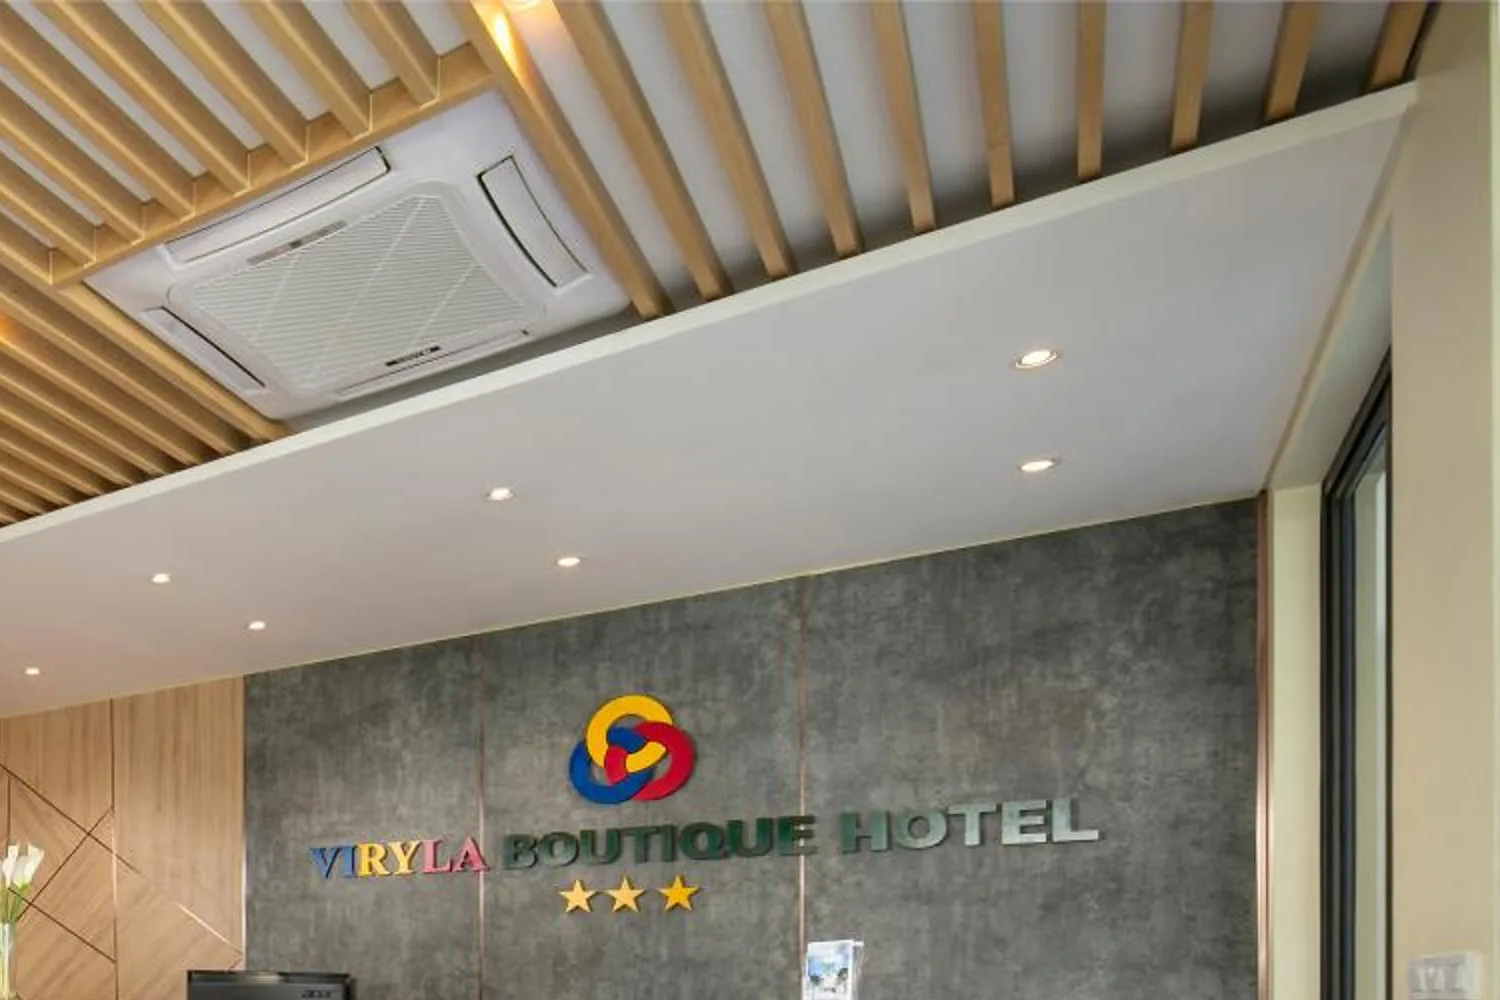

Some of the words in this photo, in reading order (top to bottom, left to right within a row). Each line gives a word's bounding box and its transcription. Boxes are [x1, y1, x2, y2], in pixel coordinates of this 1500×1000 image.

[309, 836, 490, 879] VIRYLA
[503, 816, 816, 870] BOUTIQUE
[840, 798, 1103, 855] HOTEL
